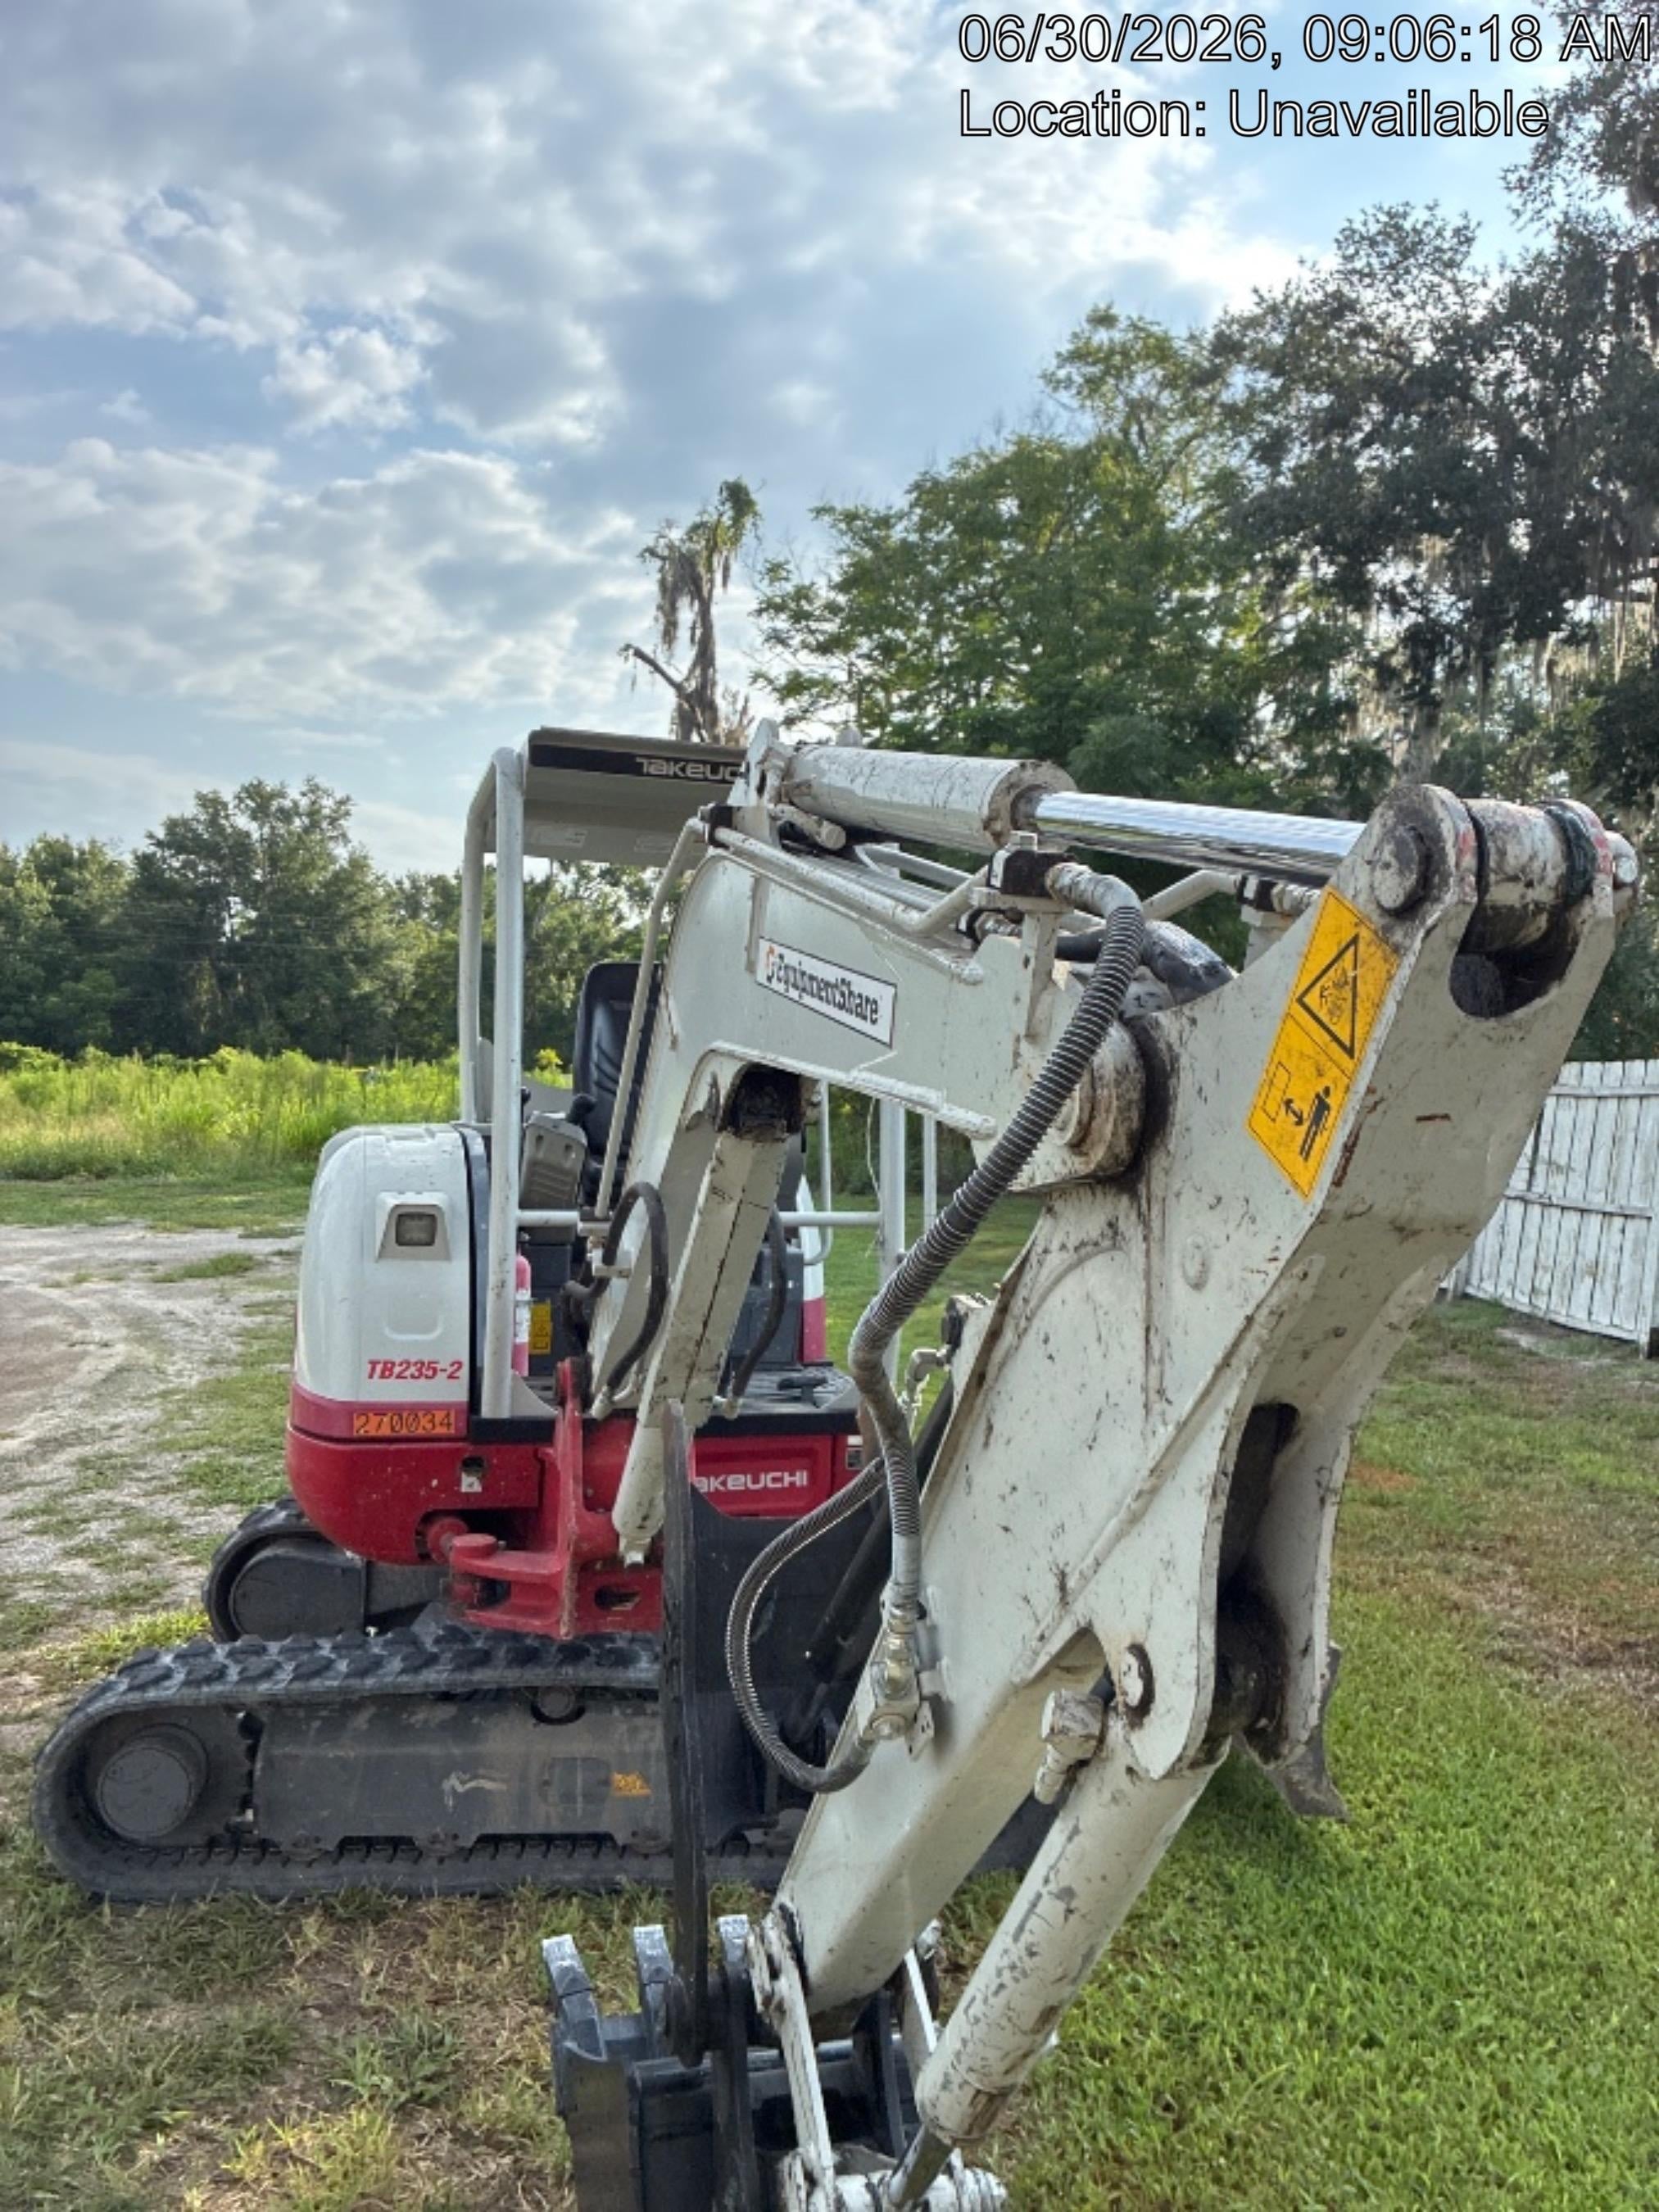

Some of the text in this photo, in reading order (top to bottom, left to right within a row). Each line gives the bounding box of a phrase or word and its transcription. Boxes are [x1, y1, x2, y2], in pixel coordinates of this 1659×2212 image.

[777, 953, 878, 1025] EquipmentShare
[367, 1359, 463, 1380] TB235-2
[356, 1411, 453, 1435] 270034
